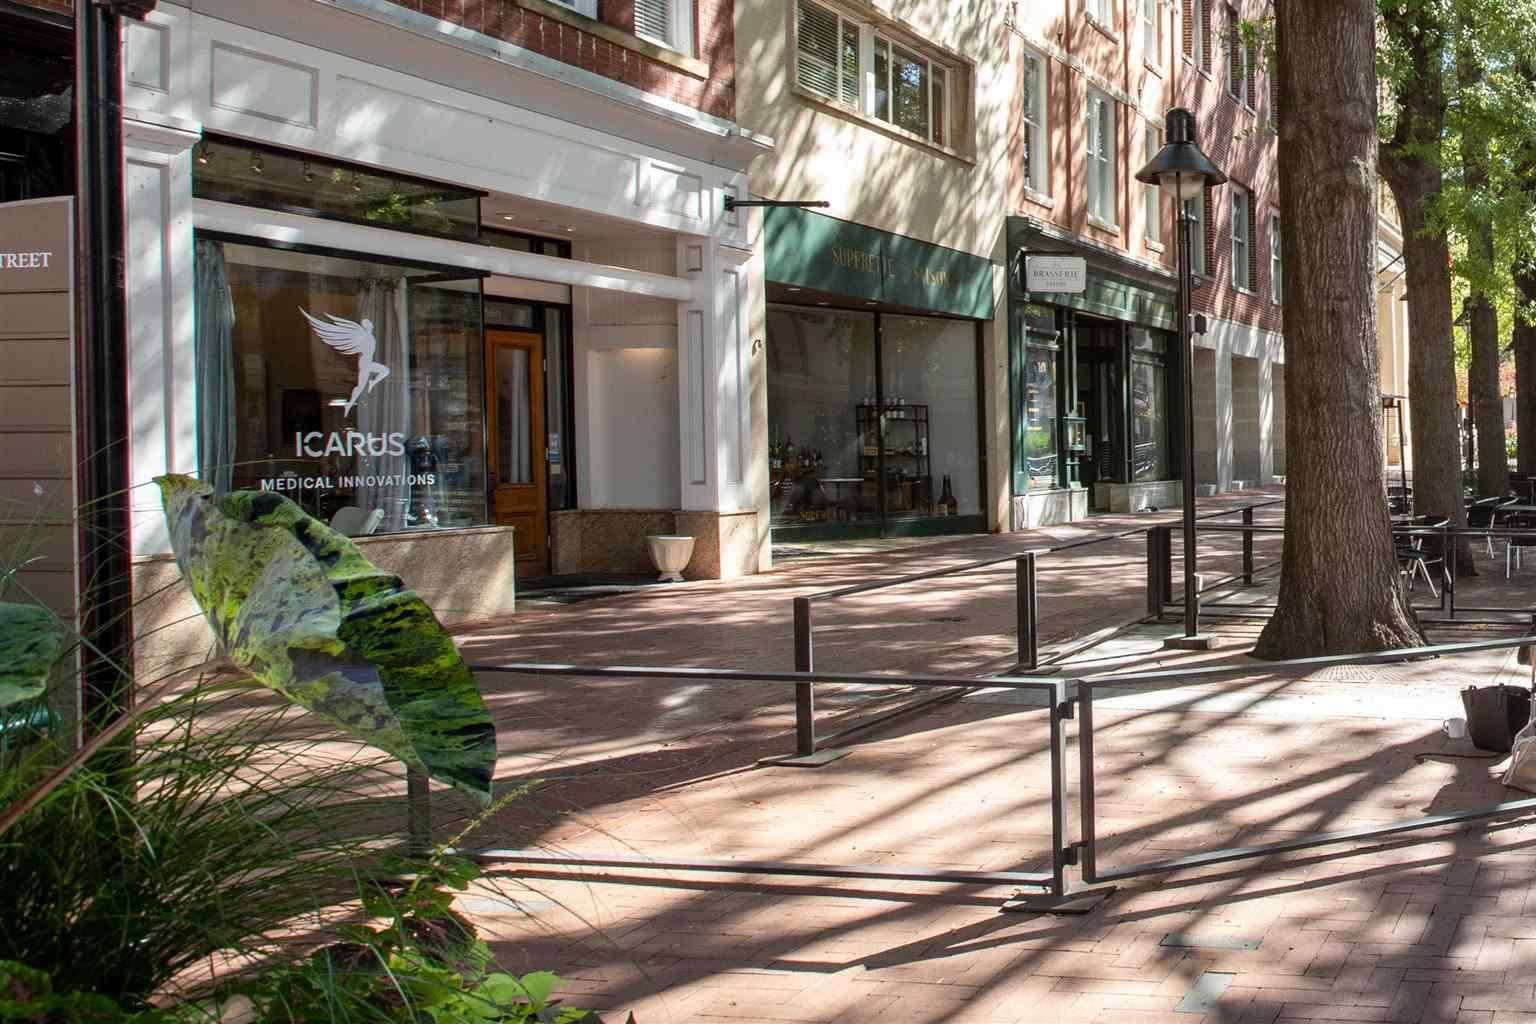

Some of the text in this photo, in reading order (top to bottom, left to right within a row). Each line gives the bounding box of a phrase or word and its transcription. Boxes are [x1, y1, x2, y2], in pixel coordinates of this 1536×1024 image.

[295, 431, 405, 457] ICARUS
[260, 474, 436, 491] MEDICAL INNOVATIONS
